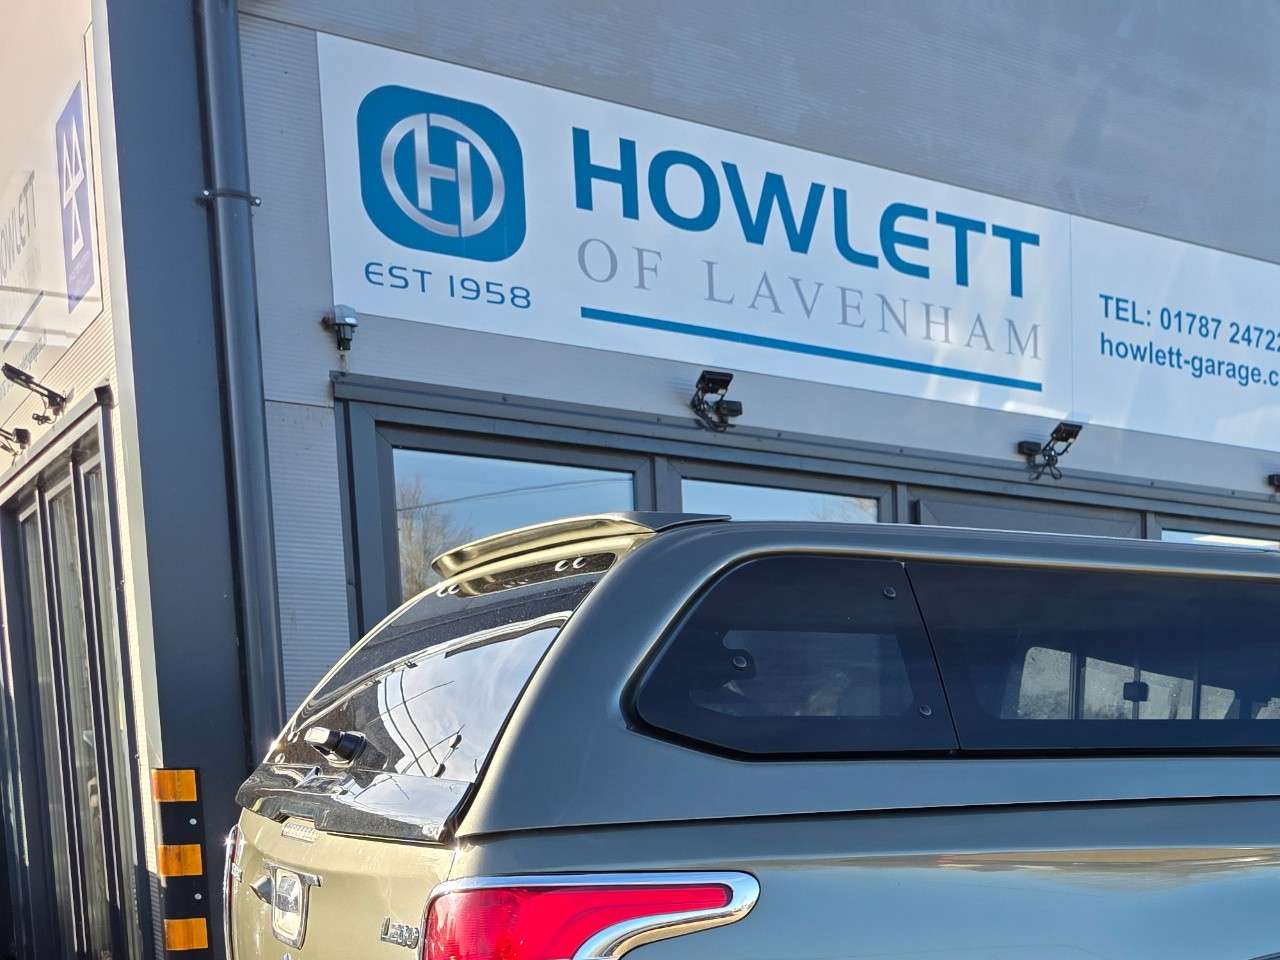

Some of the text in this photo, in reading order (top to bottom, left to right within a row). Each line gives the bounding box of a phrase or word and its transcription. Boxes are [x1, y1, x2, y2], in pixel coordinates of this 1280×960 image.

[0, 169, 36, 285] OWLETT
[572, 126, 1040, 298] HOWLETT
[364, 262, 531, 309] EST 1958
[577, 238, 1042, 360] OF LAVENHAM
[1099, 294, 1151, 327] TEL:
[1160, 307, 1222, 340] 01787
